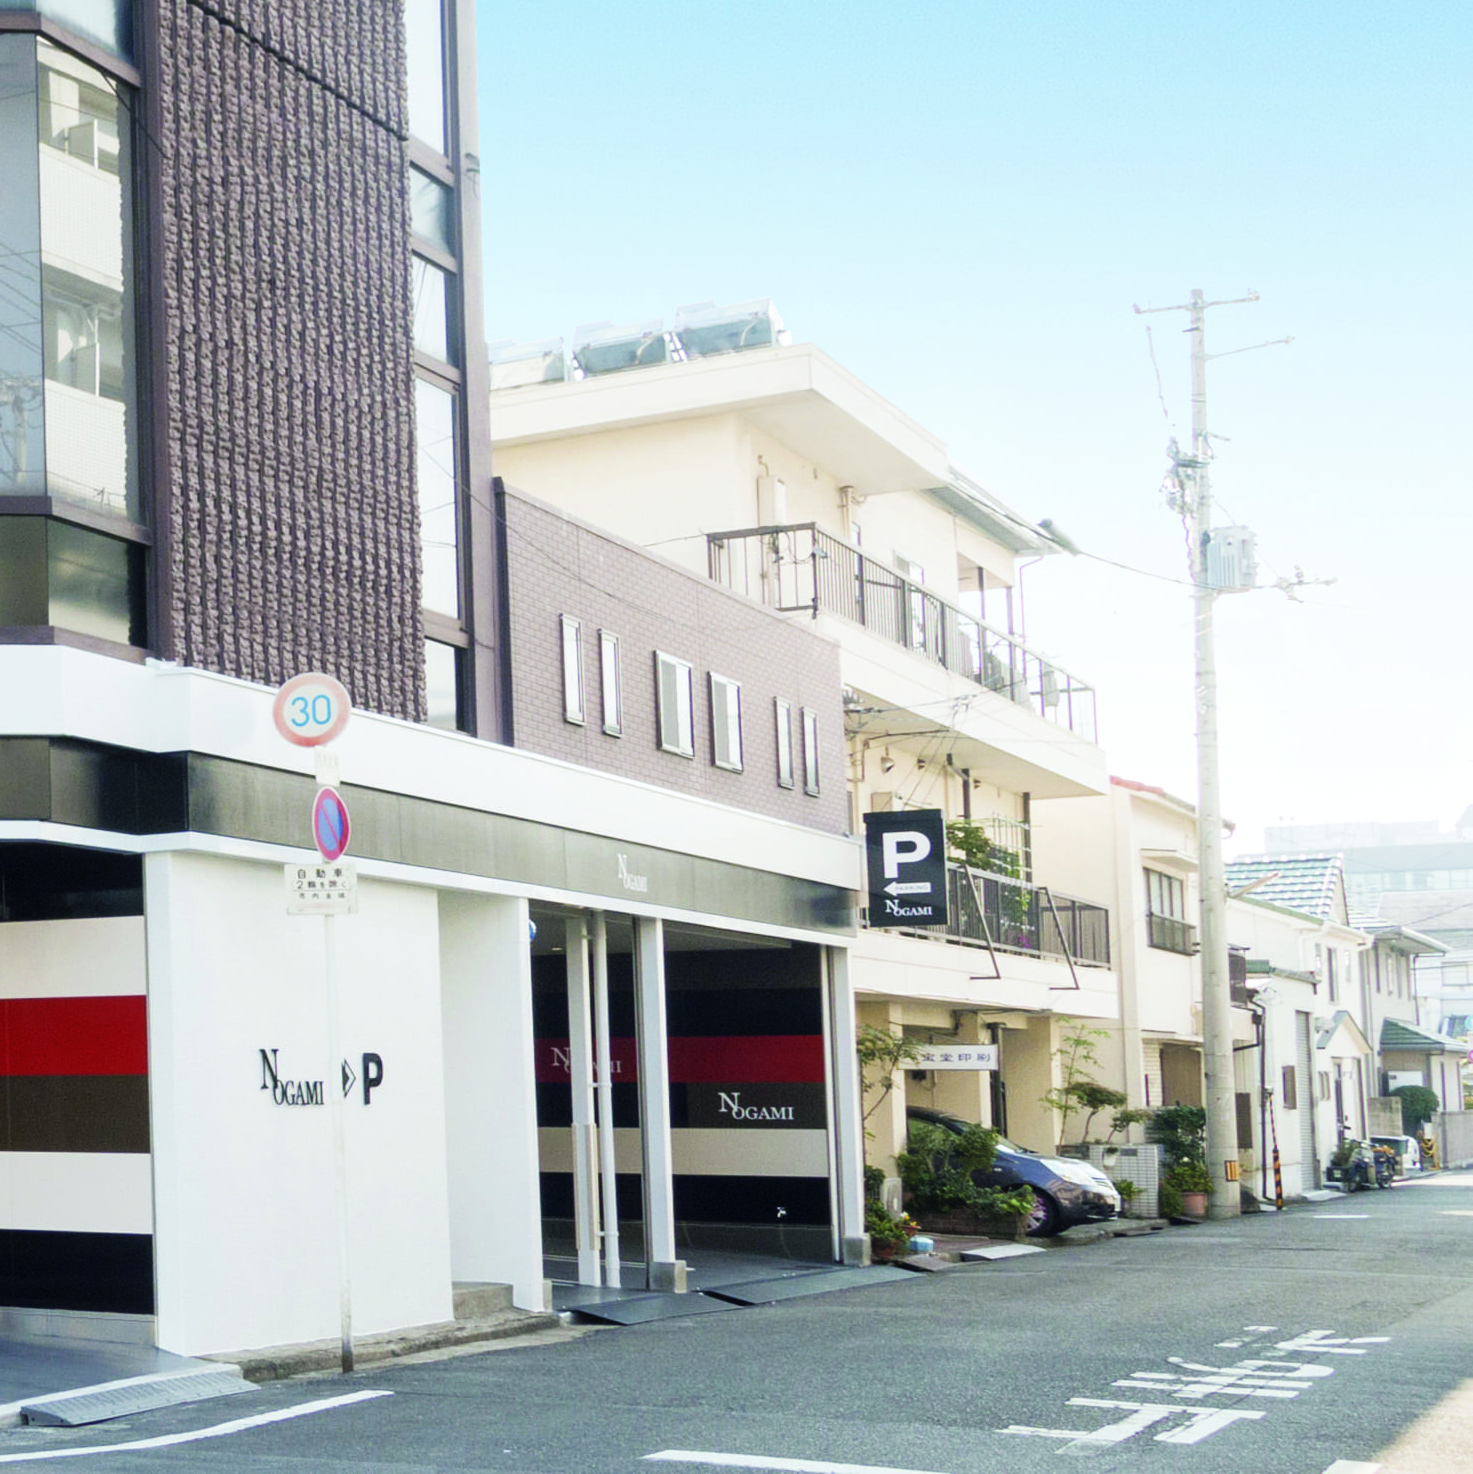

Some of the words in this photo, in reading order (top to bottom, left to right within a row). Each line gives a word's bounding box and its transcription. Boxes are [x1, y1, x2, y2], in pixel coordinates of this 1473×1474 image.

[291, 694, 331, 726] 30
[882, 831, 931, 878] P
[885, 899, 932, 916] NOGAMI
[259, 1049, 324, 1106] NOGAMI
[363, 1052, 384, 1106] P
[717, 1092, 795, 1120] NOGAMI
